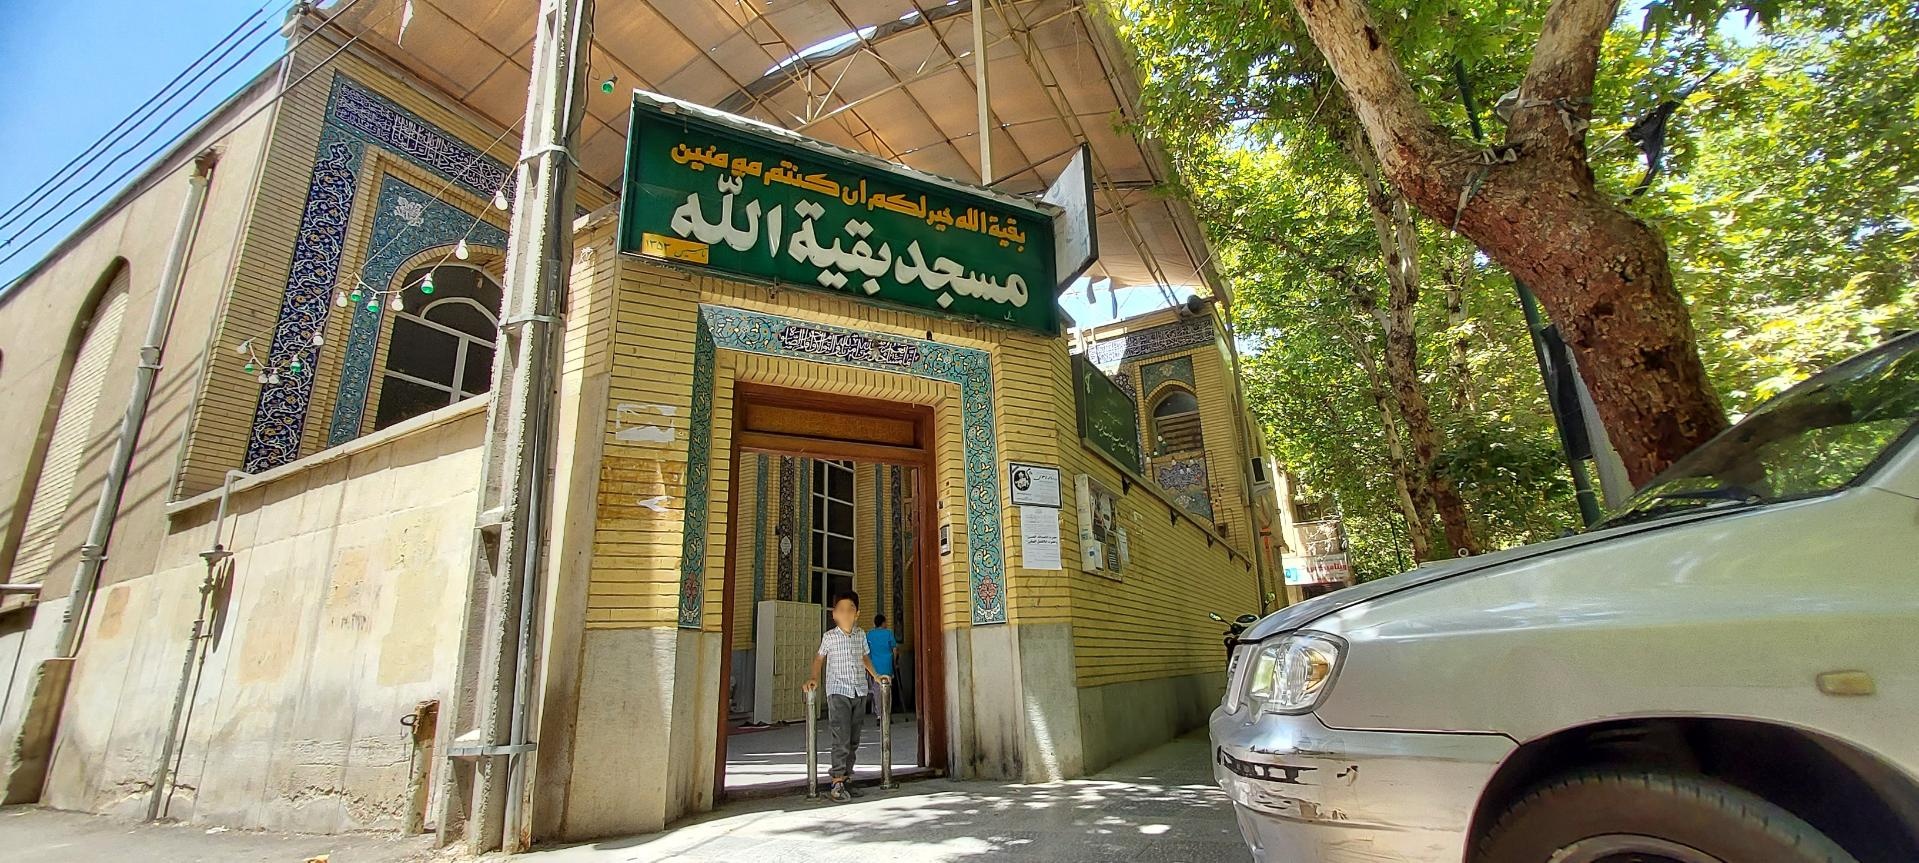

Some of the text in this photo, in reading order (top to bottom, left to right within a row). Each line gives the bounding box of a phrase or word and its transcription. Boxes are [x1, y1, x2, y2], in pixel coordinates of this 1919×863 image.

[671, 173, 1028, 308] مسجد بقية الله
